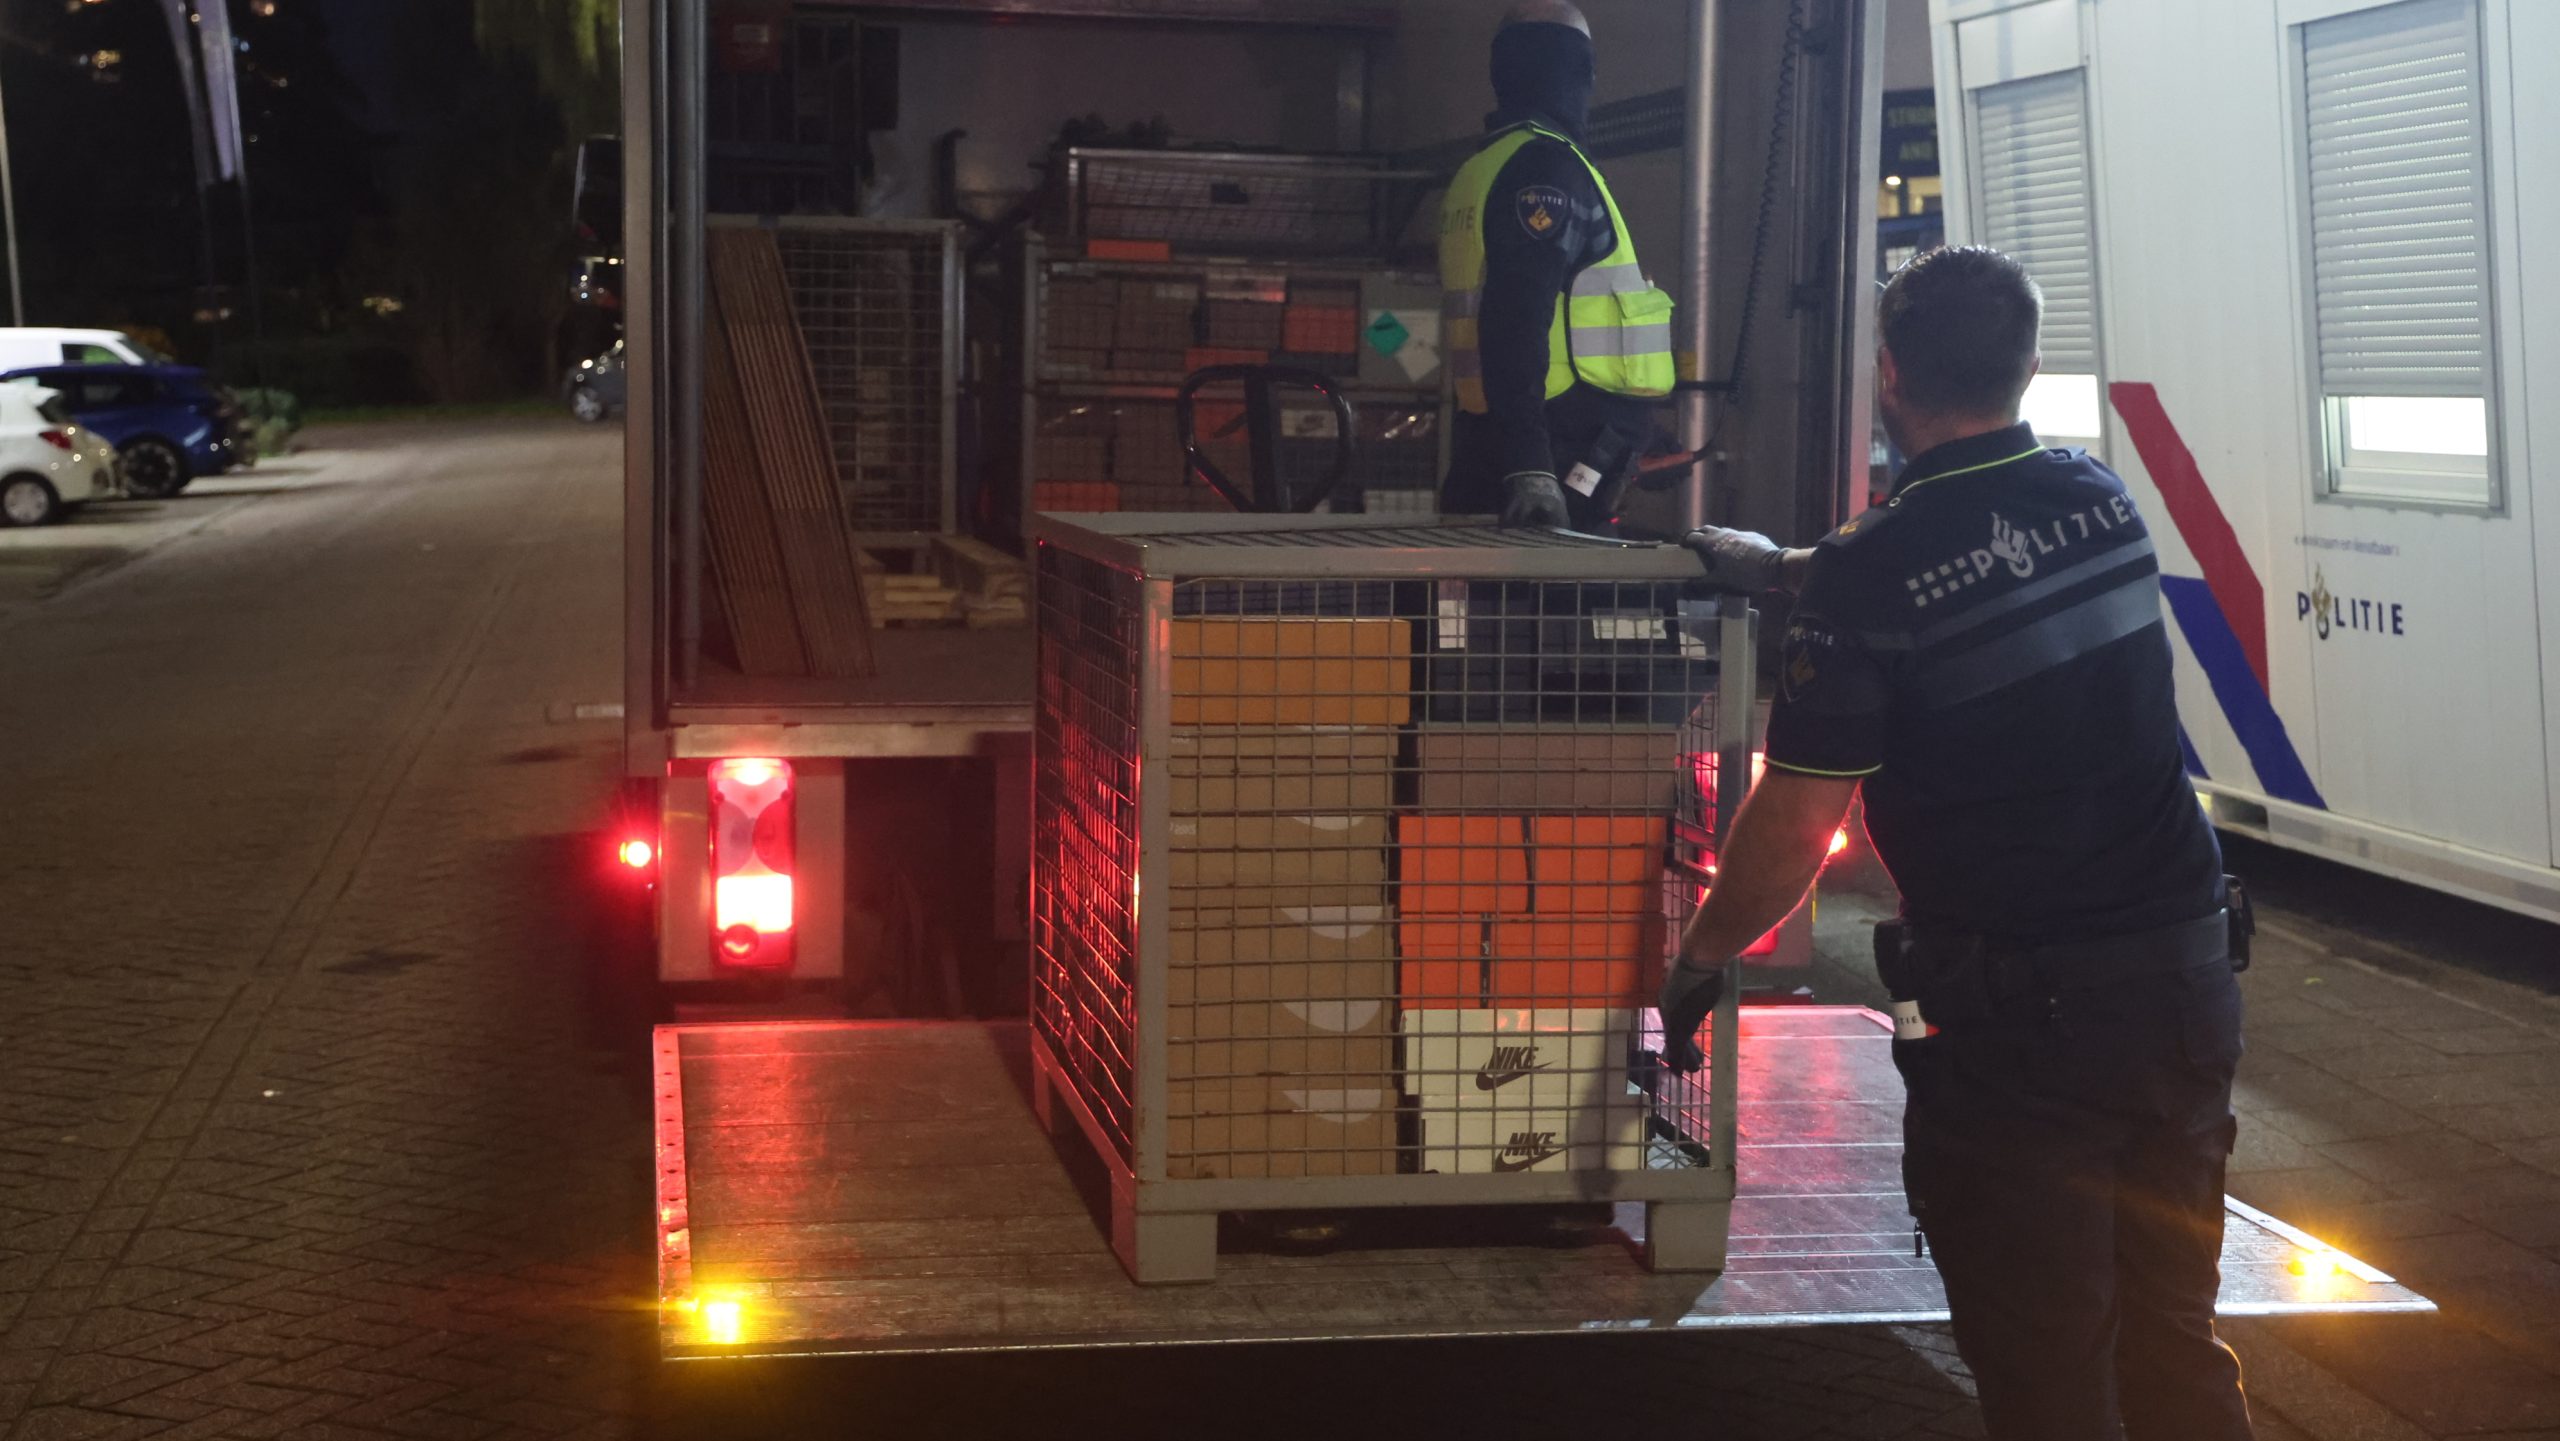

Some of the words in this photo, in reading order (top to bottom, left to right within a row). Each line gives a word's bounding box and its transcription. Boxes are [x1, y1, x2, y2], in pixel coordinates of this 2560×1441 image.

[1521, 192, 1563, 206] POLITIE
[1970, 496, 2130, 578] POLITIE
[2297, 588, 2404, 641] POLITIE
[1487, 1046, 1540, 1070] NIKE
[1504, 1132, 1556, 1157] NIKE
